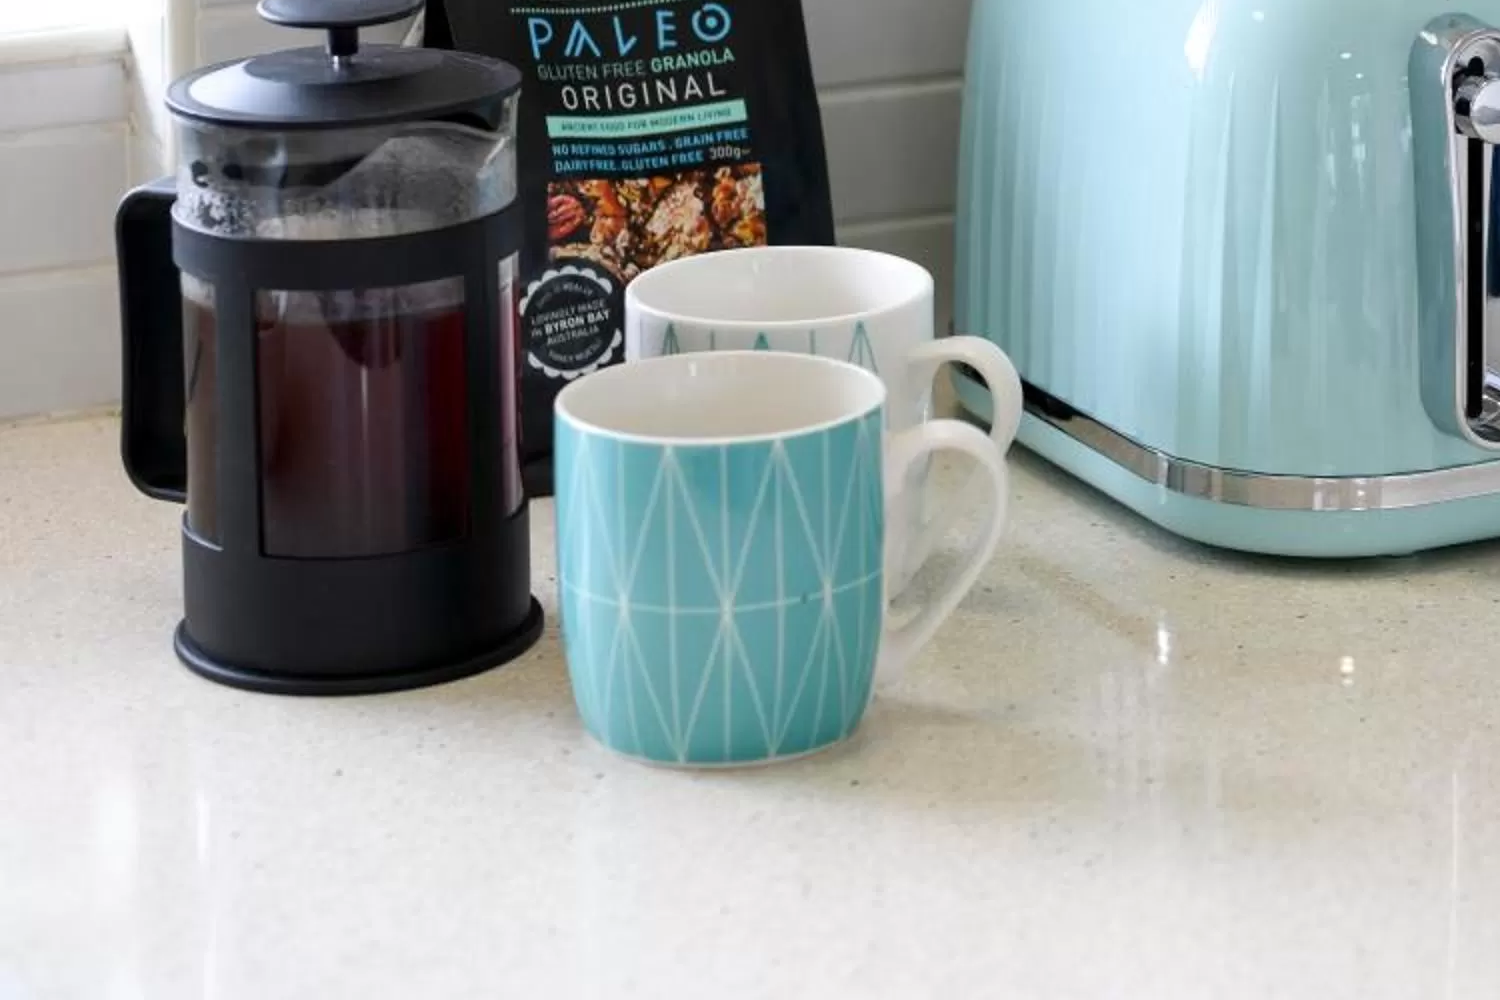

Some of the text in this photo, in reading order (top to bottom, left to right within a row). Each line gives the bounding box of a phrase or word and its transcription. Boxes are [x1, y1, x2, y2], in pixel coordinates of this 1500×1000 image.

[527, 3, 731, 60] PALEO
[537, 47, 735, 83] GLUTEN FREE GRANOLA
[561, 71, 727, 111] ORIGINAL
[553, 127, 749, 157] NO REFINED SUGARS GRAIN FREE
[710, 144, 741, 162] 300g
[671, 149, 705, 166] FREE
[544, 316, 585, 336] BYRON
[587, 309, 610, 324] BAY
[547, 325, 600, 346] AUSTRALIA
